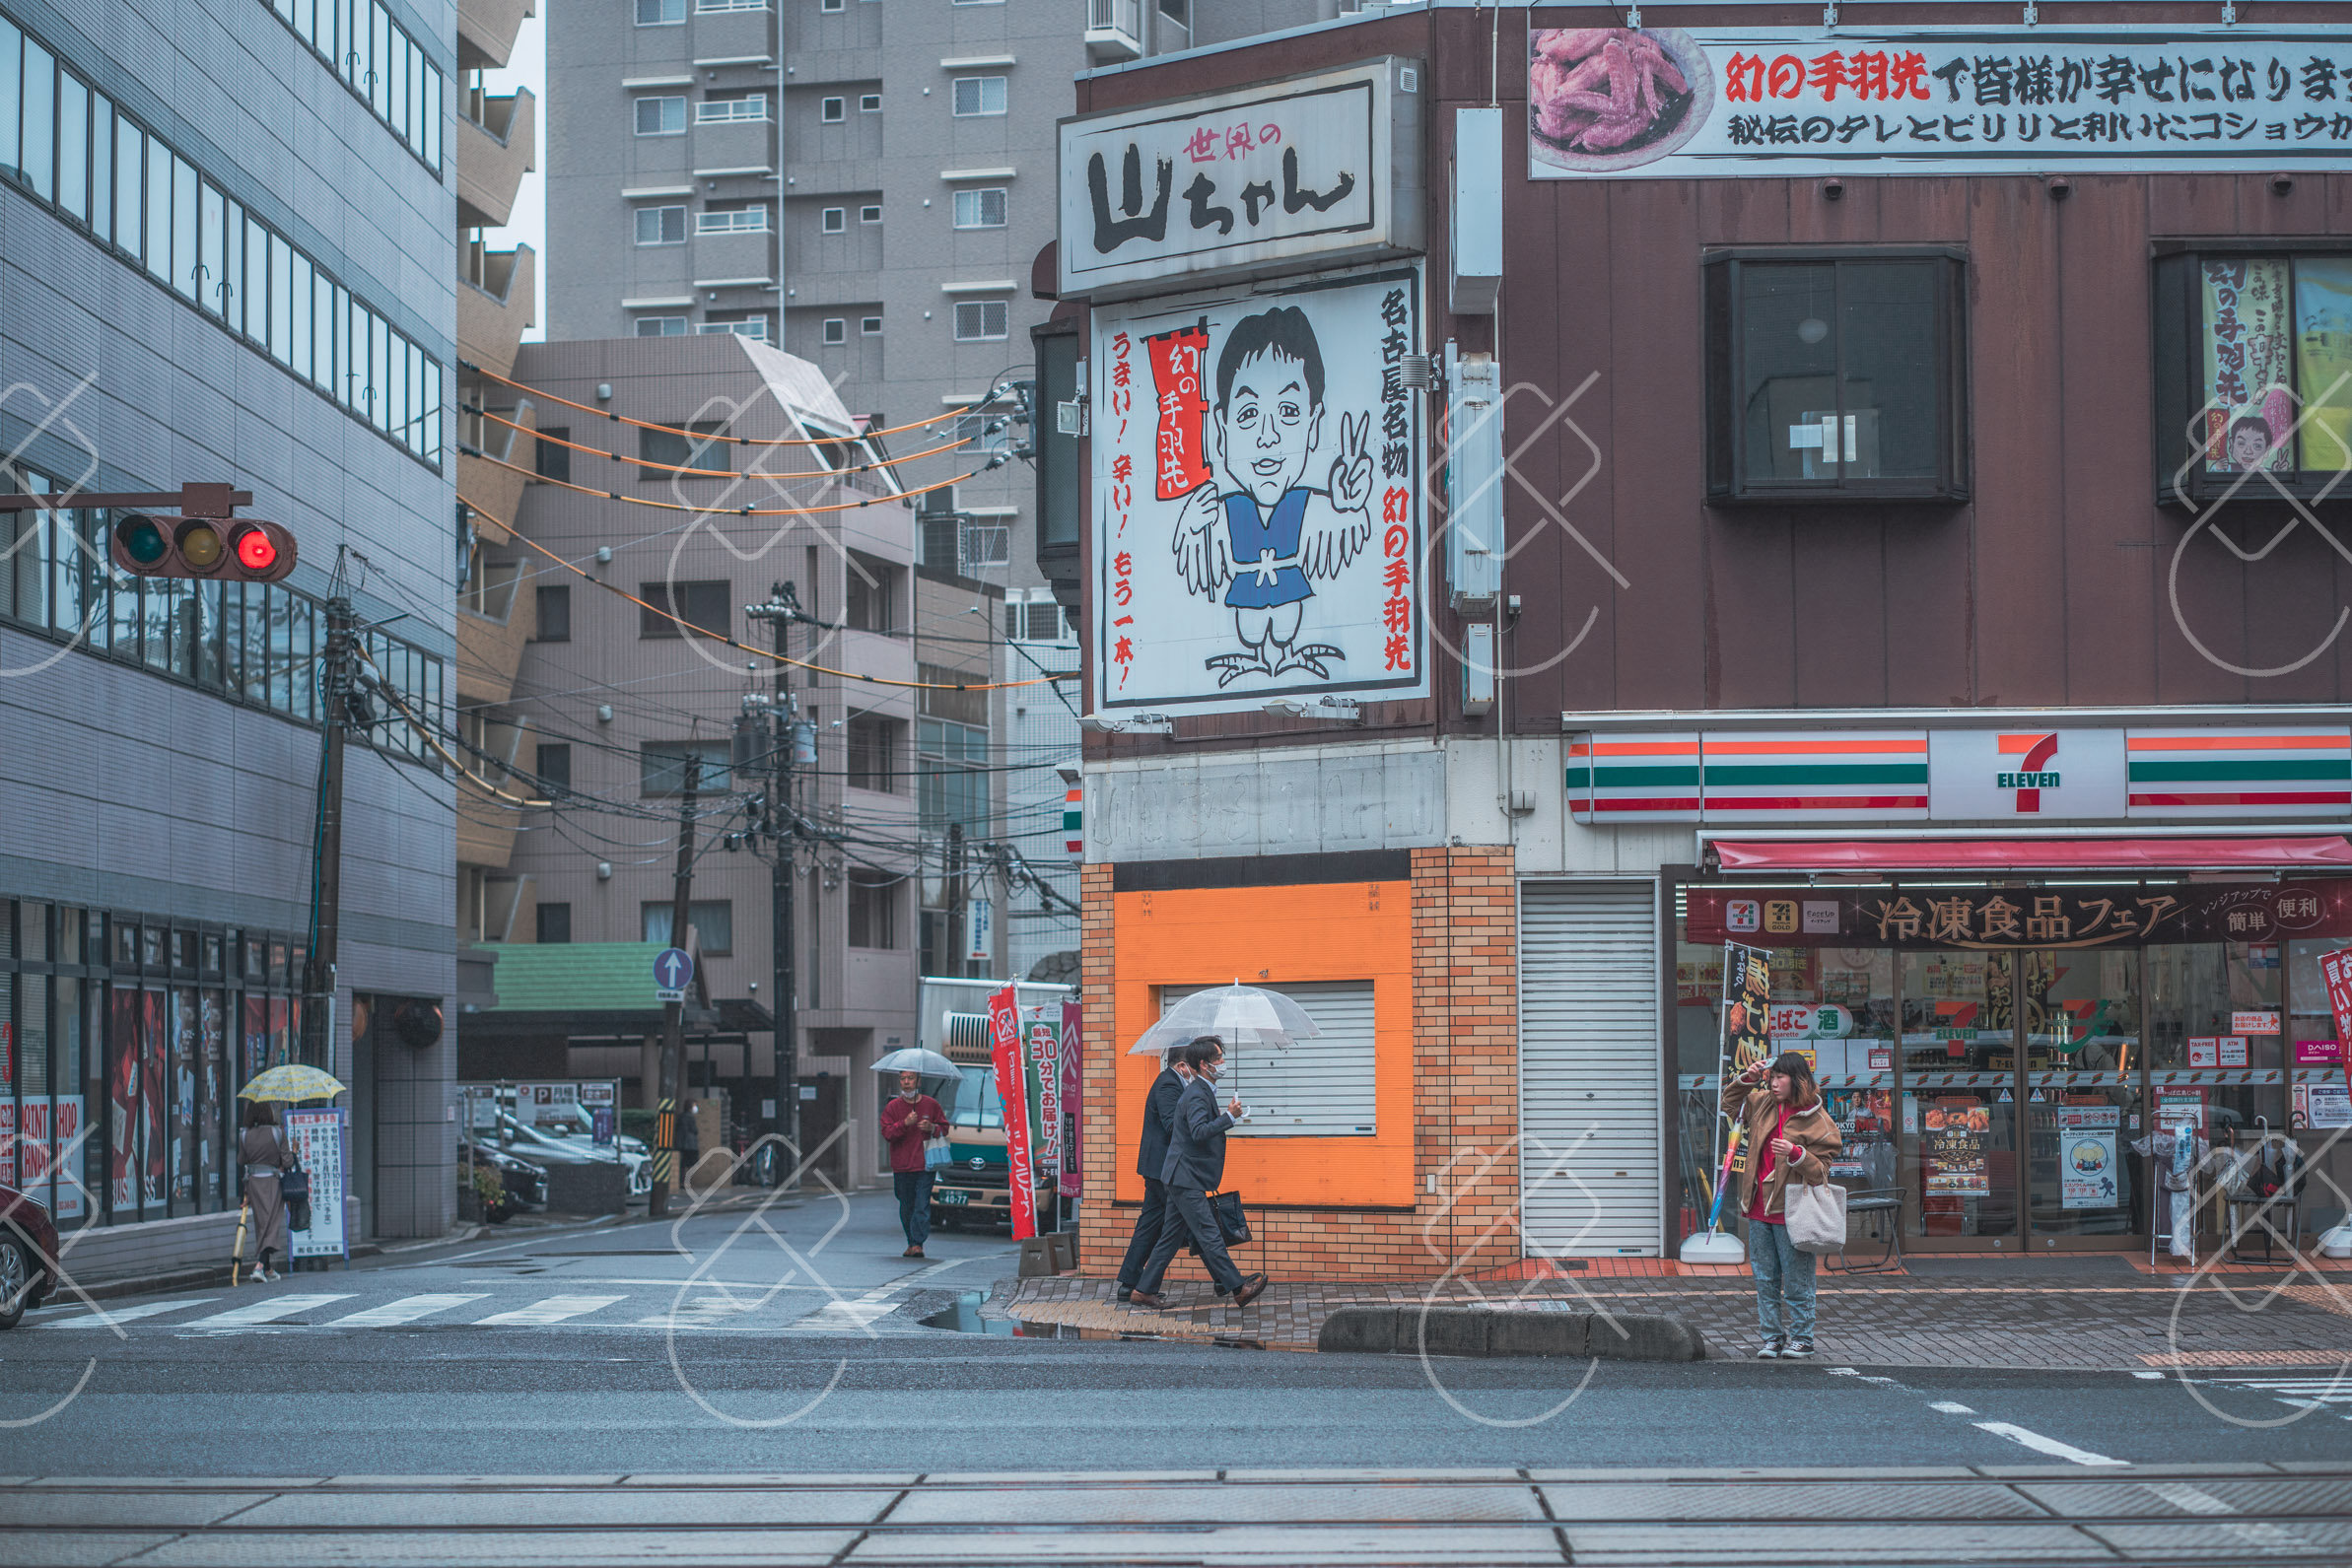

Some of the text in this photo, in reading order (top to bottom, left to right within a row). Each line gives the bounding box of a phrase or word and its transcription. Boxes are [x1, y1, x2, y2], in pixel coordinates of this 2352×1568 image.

[1724, 50, 2352, 105] 幻の手羽先で皆様が幸せになりま
[1183, 121, 1281, 164] 世界の
[1087, 142, 1355, 254] 山ちゃん
[1380, 287, 1410, 480] 名古屋名物
[1160, 342, 1199, 493] 幻の手羽先
[1382, 485, 1412, 672] 幻の手羽先
[1876, 895, 2178, 941] 冷凍食品フェア
[2227, 911, 2267, 932] 簡単
[2275, 897, 2317, 919] 便利
[1817, 1009, 1838, 1031] 酒
[1030, 1039, 1058, 1059] 30
[1934, 1138, 1980, 1151] 冷凍食品
